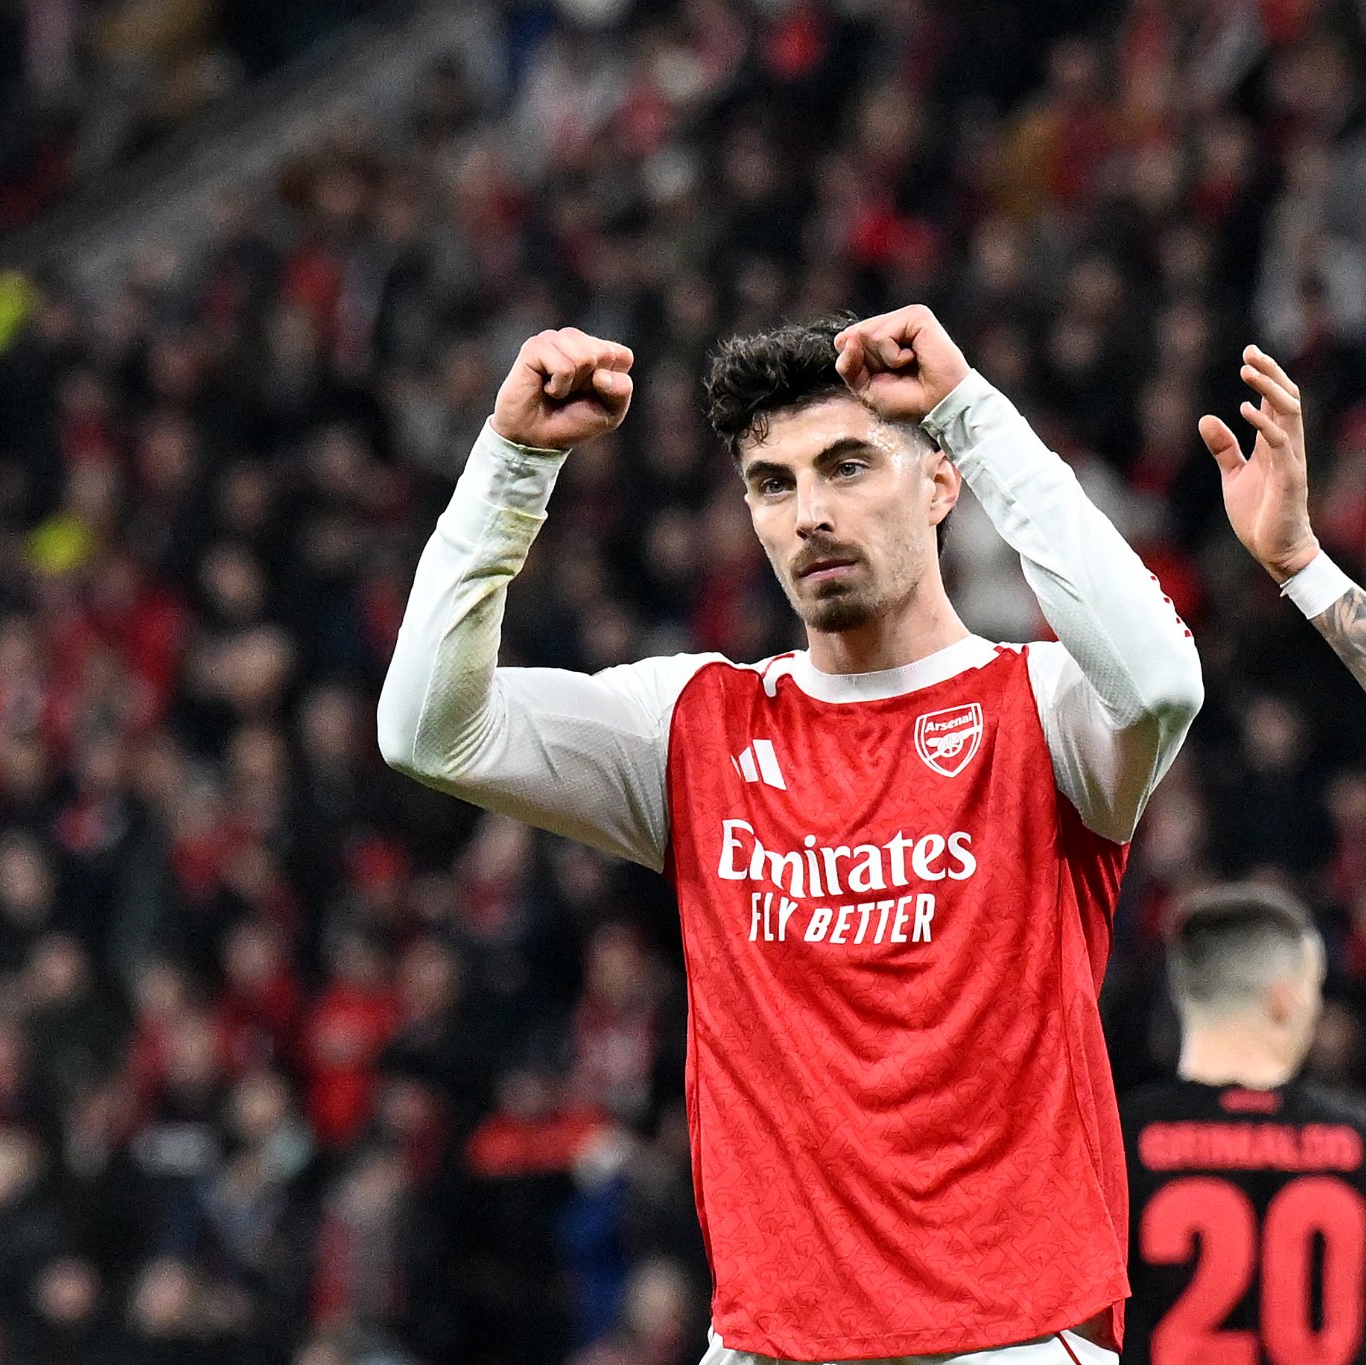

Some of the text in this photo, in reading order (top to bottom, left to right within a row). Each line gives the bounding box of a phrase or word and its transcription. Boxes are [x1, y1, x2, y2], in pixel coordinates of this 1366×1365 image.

[925, 711, 973, 733] Arsenal
[717, 819, 977, 898] Emirates
[748, 891, 936, 944] FLY BETTER
